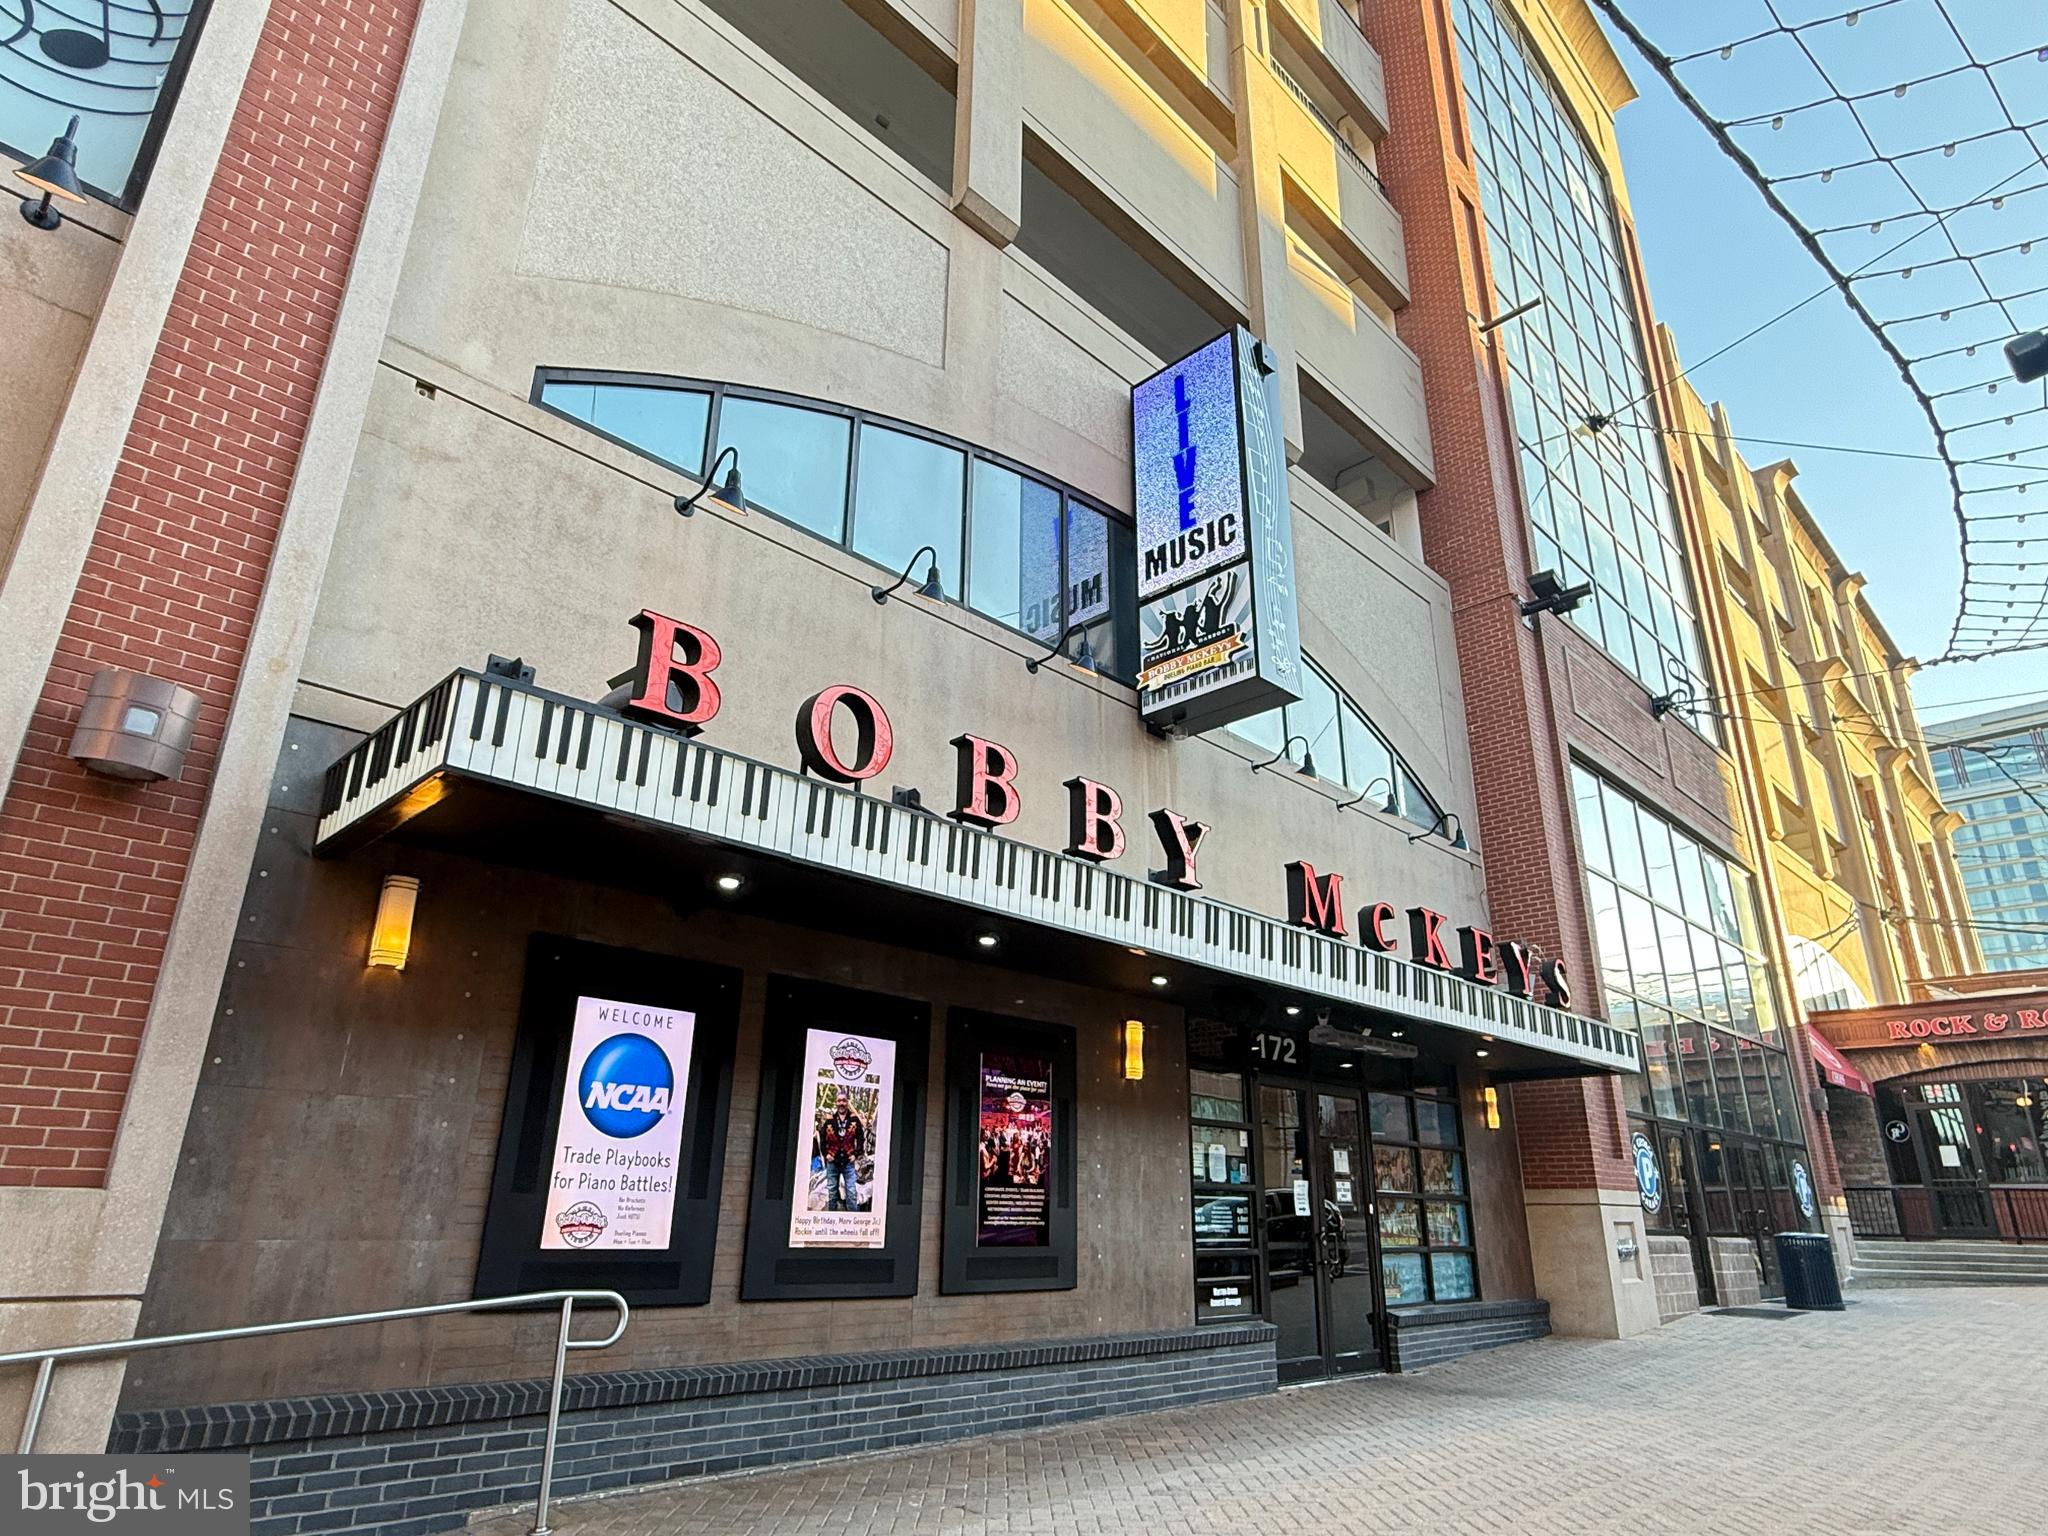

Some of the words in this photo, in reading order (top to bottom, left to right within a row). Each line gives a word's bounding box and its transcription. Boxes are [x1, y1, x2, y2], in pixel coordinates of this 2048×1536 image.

[1173, 374, 1197, 532] LIVE
[1144, 513, 1236, 581] MUSIC
[1151, 645, 1185, 661] NATIONAL
[1148, 658, 1185, 680] BOBBY
[1163, 668, 1186, 681] DUELING
[1186, 660, 1203, 672] PIANO
[1203, 656, 1215, 666] BAR
[628, 608, 1212, 890] BOBBY
[599, 1006, 674, 1030] WELCOME
[1886, 1014, 1977, 1040] ROCK
[1984, 1013, 2009, 1032] &
[1256, 1033, 1297, 1064] 172
[985, 1074, 1016, 1086] PLANNING
[1017, 1078, 1026, 1086] AN
[1026, 1079, 1048, 1088] EVENT?
[585, 1080, 670, 1115] NCAA
[564, 1146, 601, 1165] Trade
[605, 1148, 671, 1170] Playbooks
[554, 1171, 575, 1189] for
[578, 1172, 616, 1191] Piano
[620, 1174, 673, 1193] Battles!
[1641, 1156, 1653, 1190] P
[794, 1215, 811, 1226] Happy
[813, 1215, 838, 1226] Birthday,
[853, 1216, 871, 1226] George
[794, 1226, 814, 1236] Rockin'
[815, 1228, 828, 1236] until
[829, 1228, 839, 1236] the
[840, 1228, 858, 1236] wheels
[859, 1228, 868, 1236] fall
